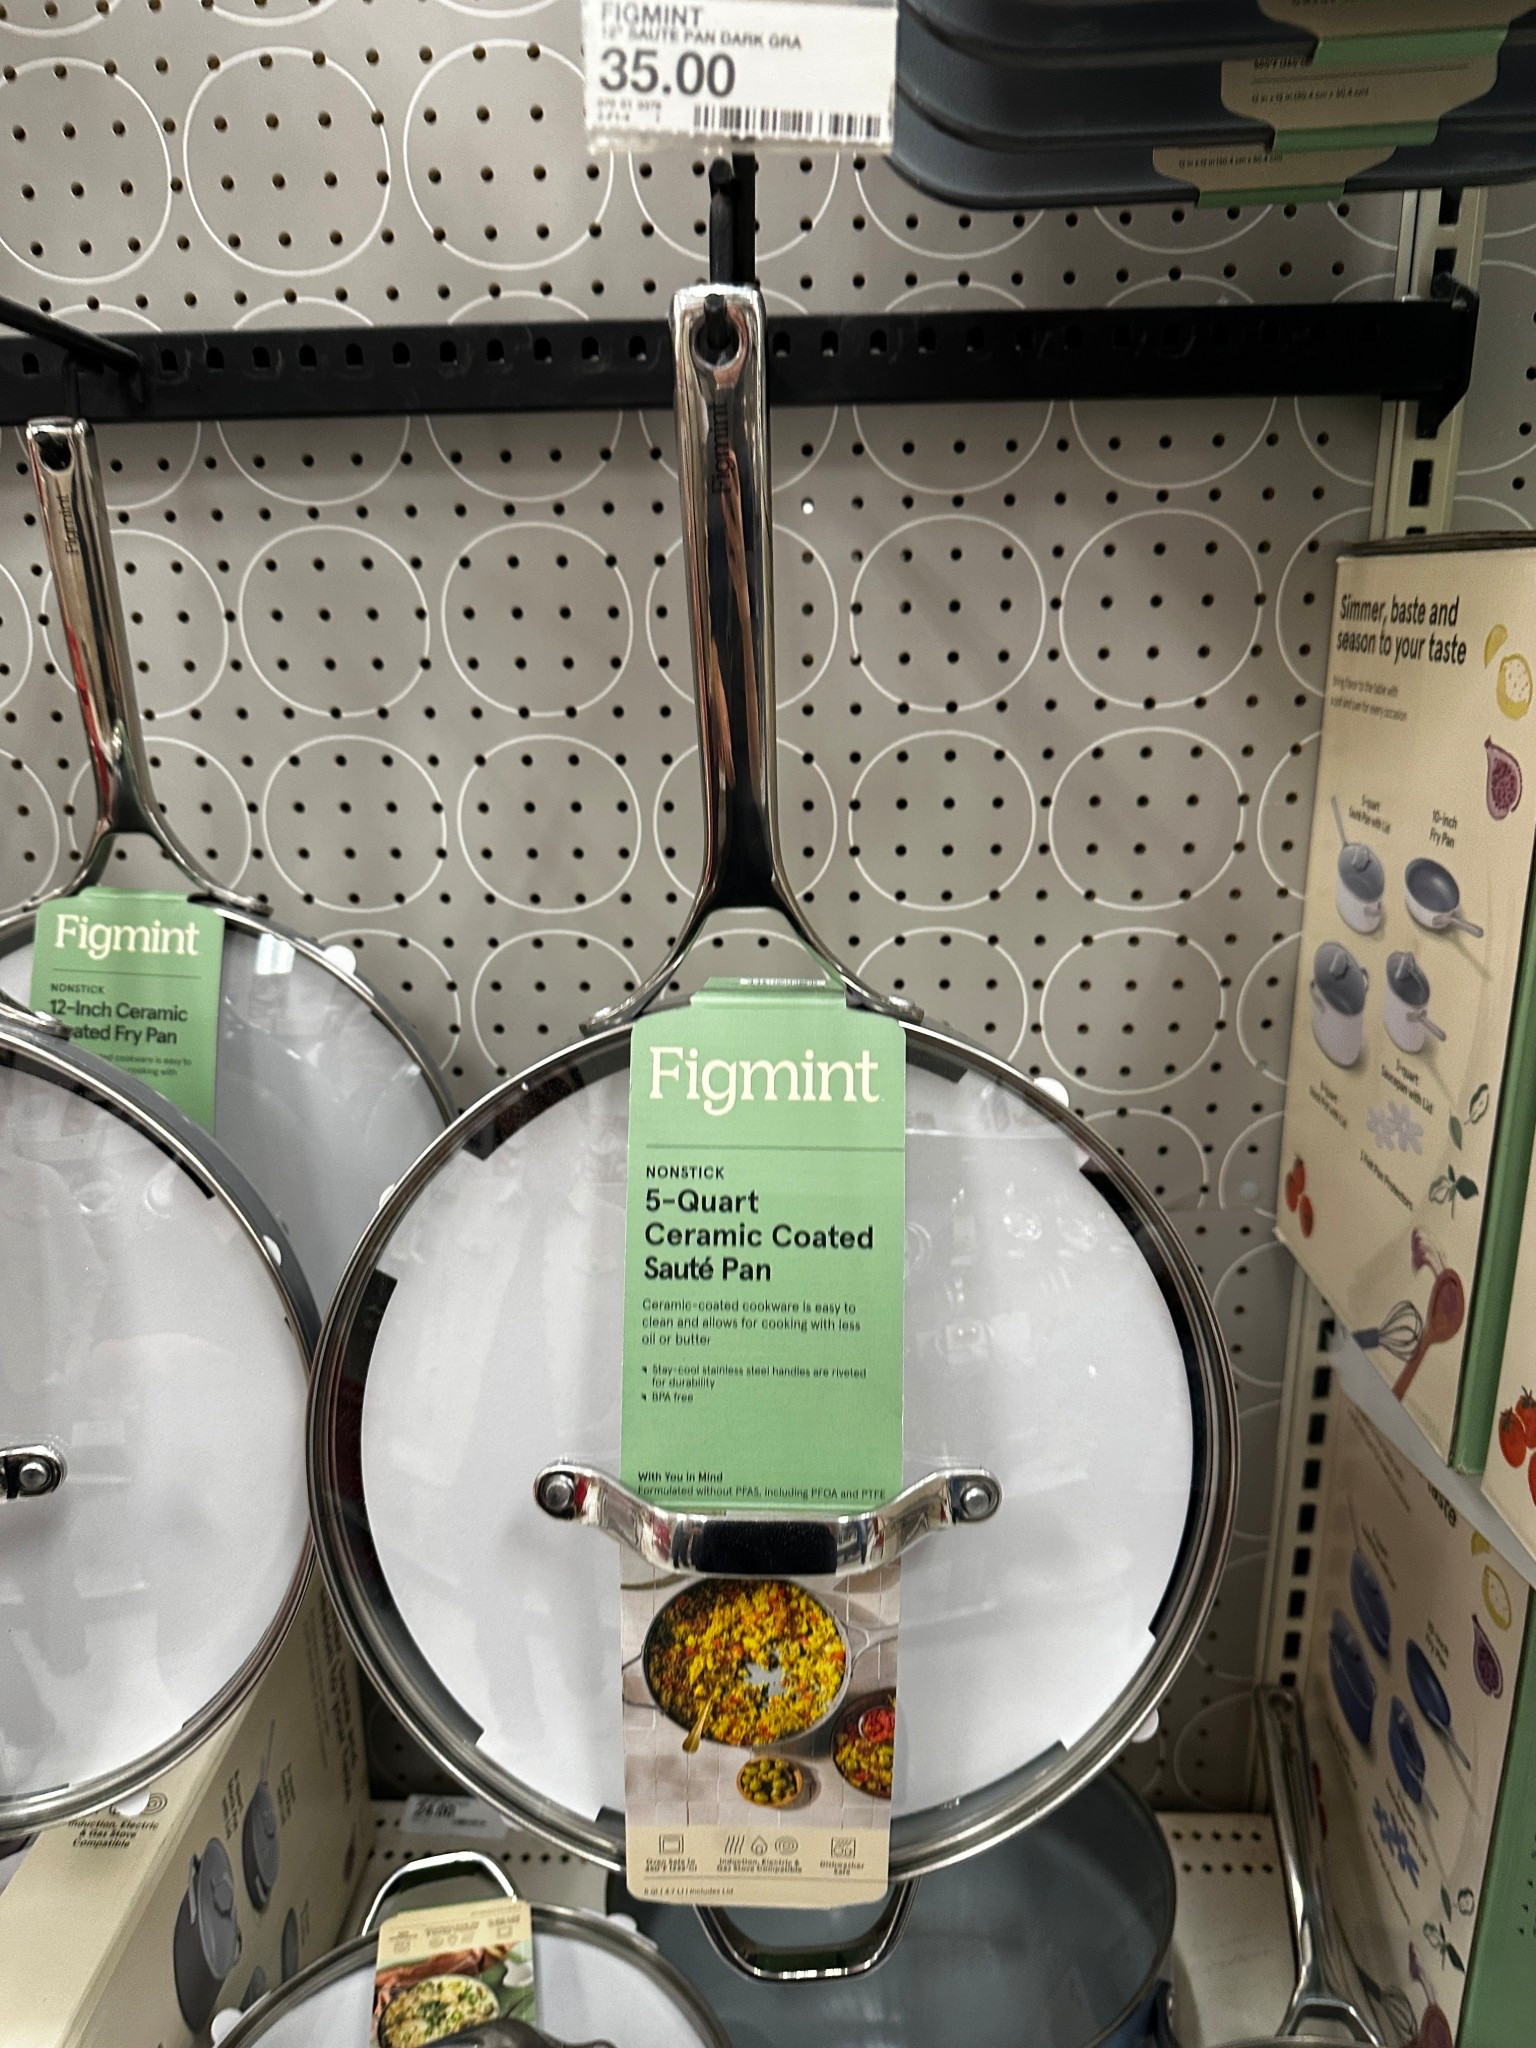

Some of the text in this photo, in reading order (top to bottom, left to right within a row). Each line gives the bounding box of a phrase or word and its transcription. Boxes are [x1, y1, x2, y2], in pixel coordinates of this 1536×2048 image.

[600, 3, 702, 27] FIGMINT
[684, 31, 715, 45] PAN
[720, 31, 763, 47] DARK
[768, 33, 802, 50] GRA
[600, 48, 736, 97] 35.00
[1340, 593, 1461, 628] Simmer, baste and
[1336, 629, 1467, 666] season to your taste
[1431, 809, 1458, 830] 10-inch
[1441, 831, 1455, 849] Pan
[55, 913, 200, 960] Figmint
[50, 982, 105, 995] NONSTICK
[50, 999, 189, 1023] 12-Inch Ceramic
[72, 1025, 178, 1046] ated Fry Pan
[650, 1046, 880, 1117] Figmint
[646, 1165, 725, 1180] NONSTICK
[645, 1188, 760, 1215] 5-Quart
[644, 1221, 875, 1251] Ceramic Coated
[644, 1255, 772, 1282] Sauté Pan
[641, 1298, 857, 1317] Ceramic-coated cookware is easy to
[642, 1315, 861, 1334] clean and allows for cooking with less
[641, 1331, 711, 1346] oil or butter
[652, 1363, 867, 1380] Stay-cool stainless steel handles are riveted
[652, 1376, 716, 1390] for durability
[651, 1391, 694, 1403] BPA free
[637, 1470, 724, 1483] With You in Mind
[637, 1485, 694, 1497] Formulated
[696, 1485, 732, 1497] without
[764, 1486, 808, 1501] including
[811, 1487, 838, 1499] PFOA
[840, 1487, 859, 1500] and
[861, 1488, 886, 1500] PTFE
[120, 1820, 159, 1831] Electric
